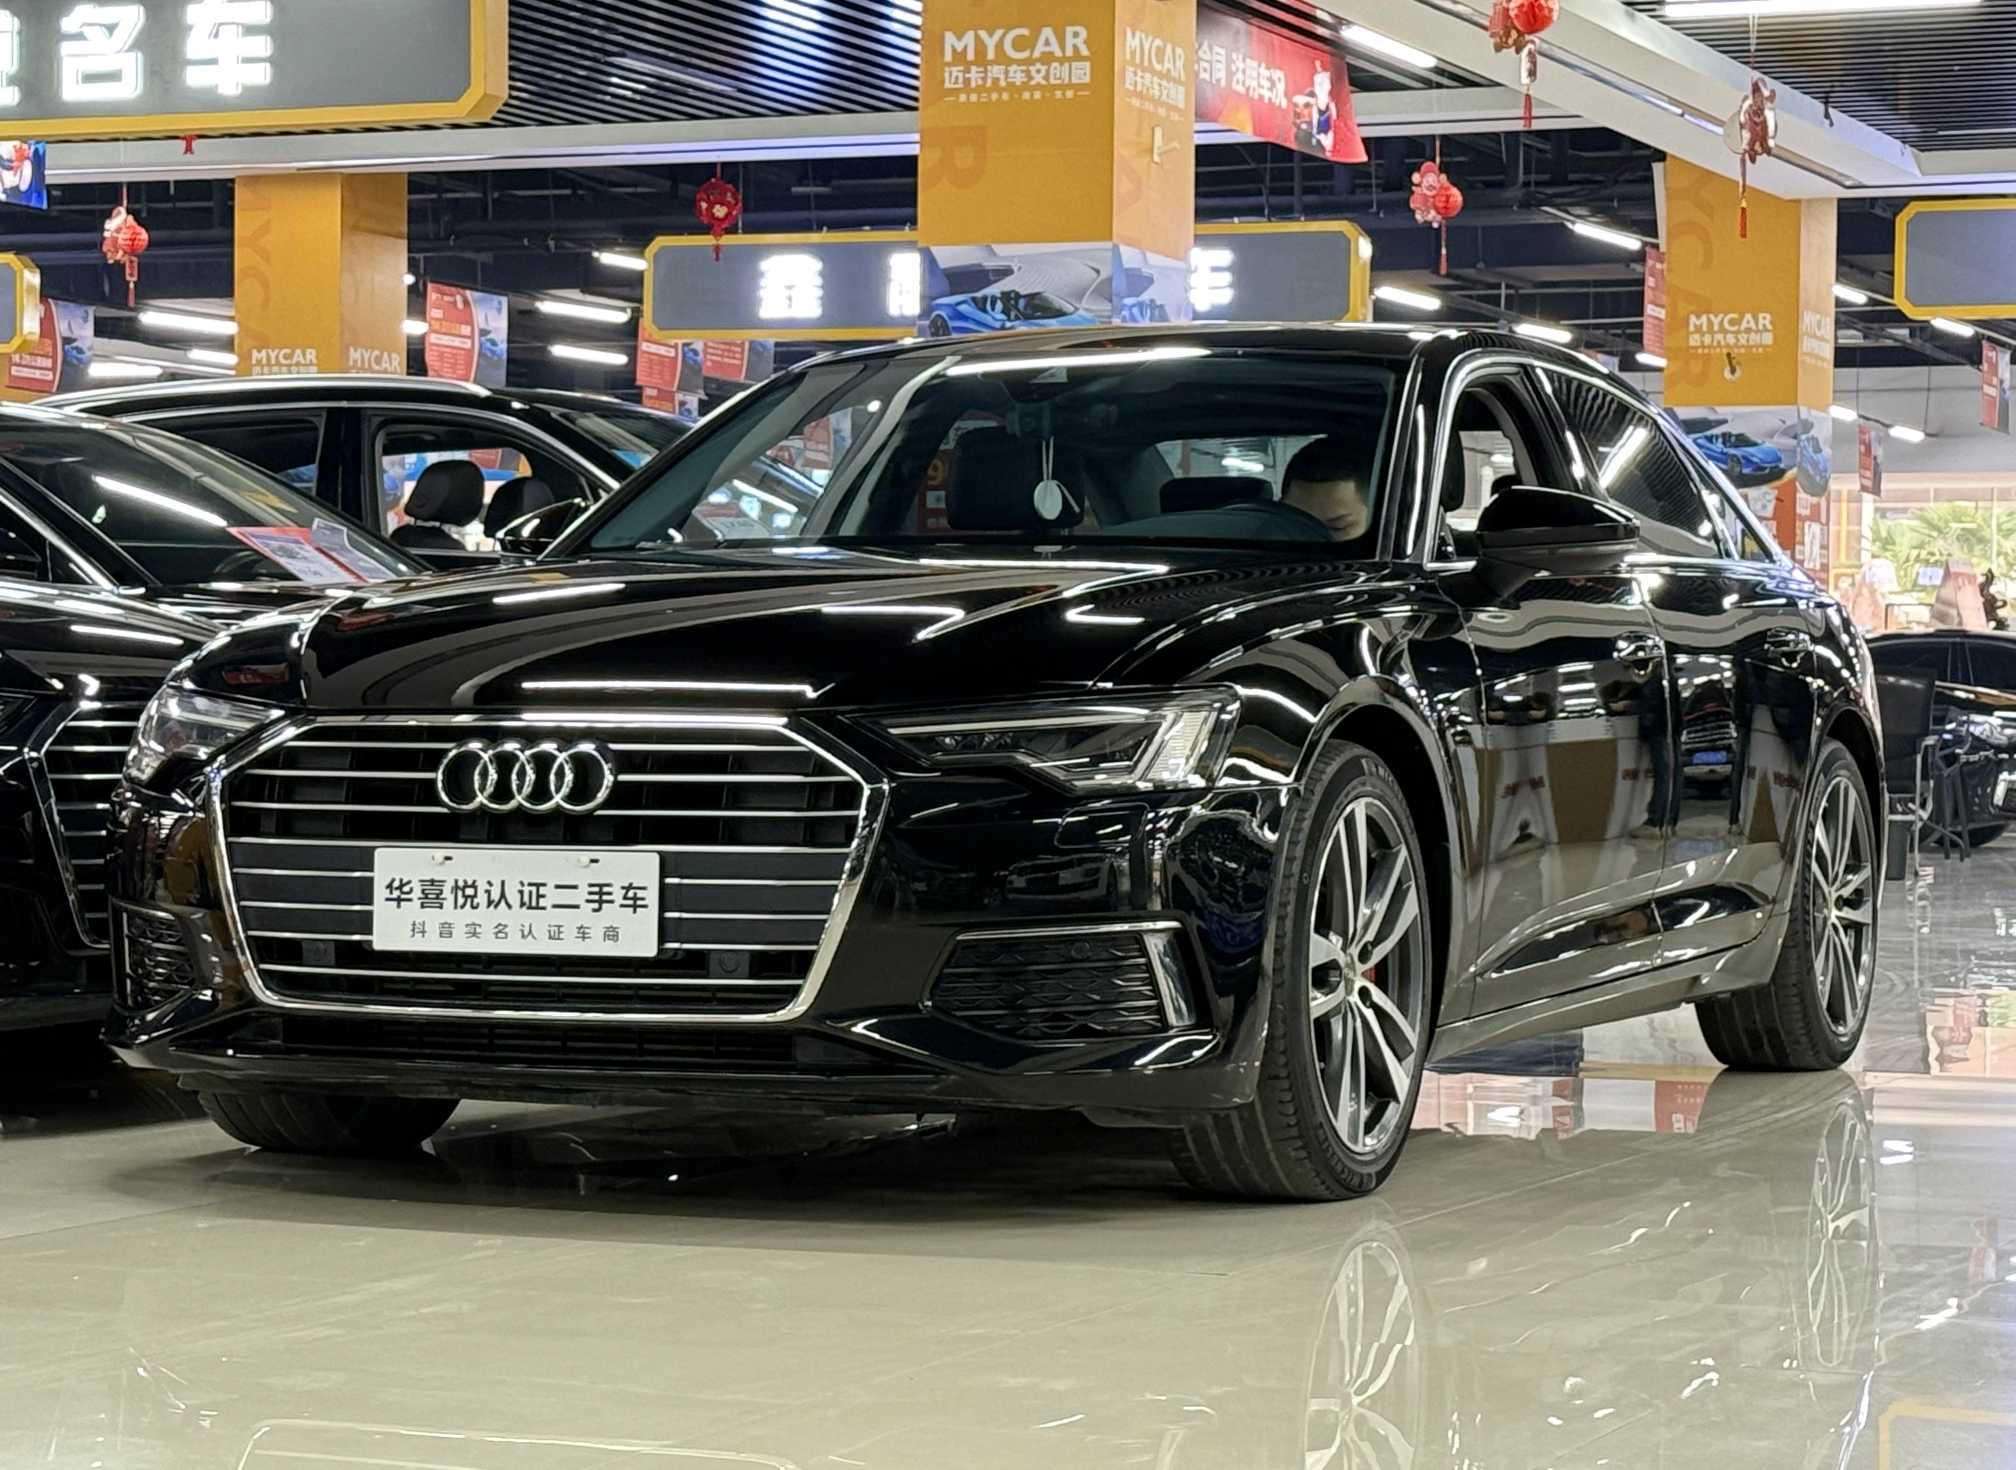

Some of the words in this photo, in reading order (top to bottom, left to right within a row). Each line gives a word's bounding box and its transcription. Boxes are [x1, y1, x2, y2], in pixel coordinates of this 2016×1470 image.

[943, 25, 1091, 62] MYCAR
[1124, 26, 1186, 82] MYCAR
[943, 61, 1091, 89] 迈卡汽车文创园
[1194, 39, 1226, 88] 合同
[1231, 51, 1288, 109] 注明车况
[1688, 312, 1774, 332] MYCAR
[251, 348, 318, 366] MYCAR
[349, 345, 401, 373] MYCAR
[384, 877, 650, 914] 华喜悦认证二手车
[410, 919, 622, 943] 抖音实名认证车商
